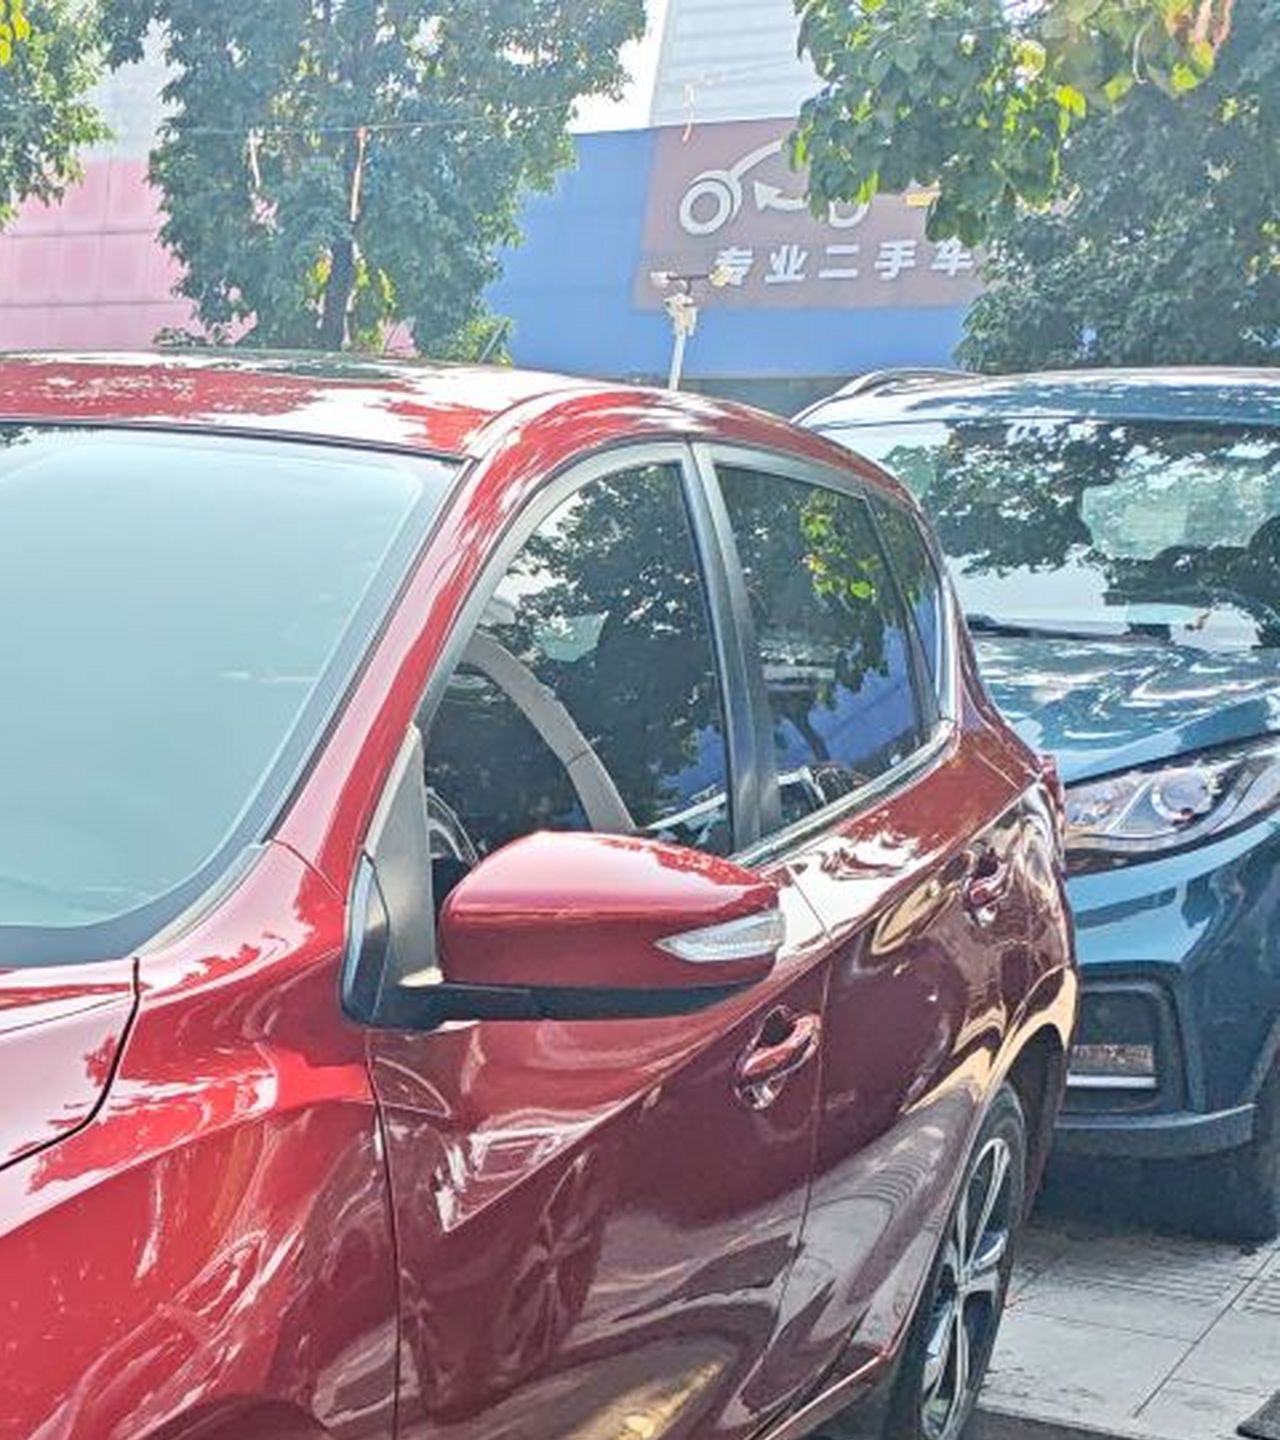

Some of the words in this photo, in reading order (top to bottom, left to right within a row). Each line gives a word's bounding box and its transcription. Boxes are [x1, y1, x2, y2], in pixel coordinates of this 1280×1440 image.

[711, 236, 974, 285] 专业二手车
